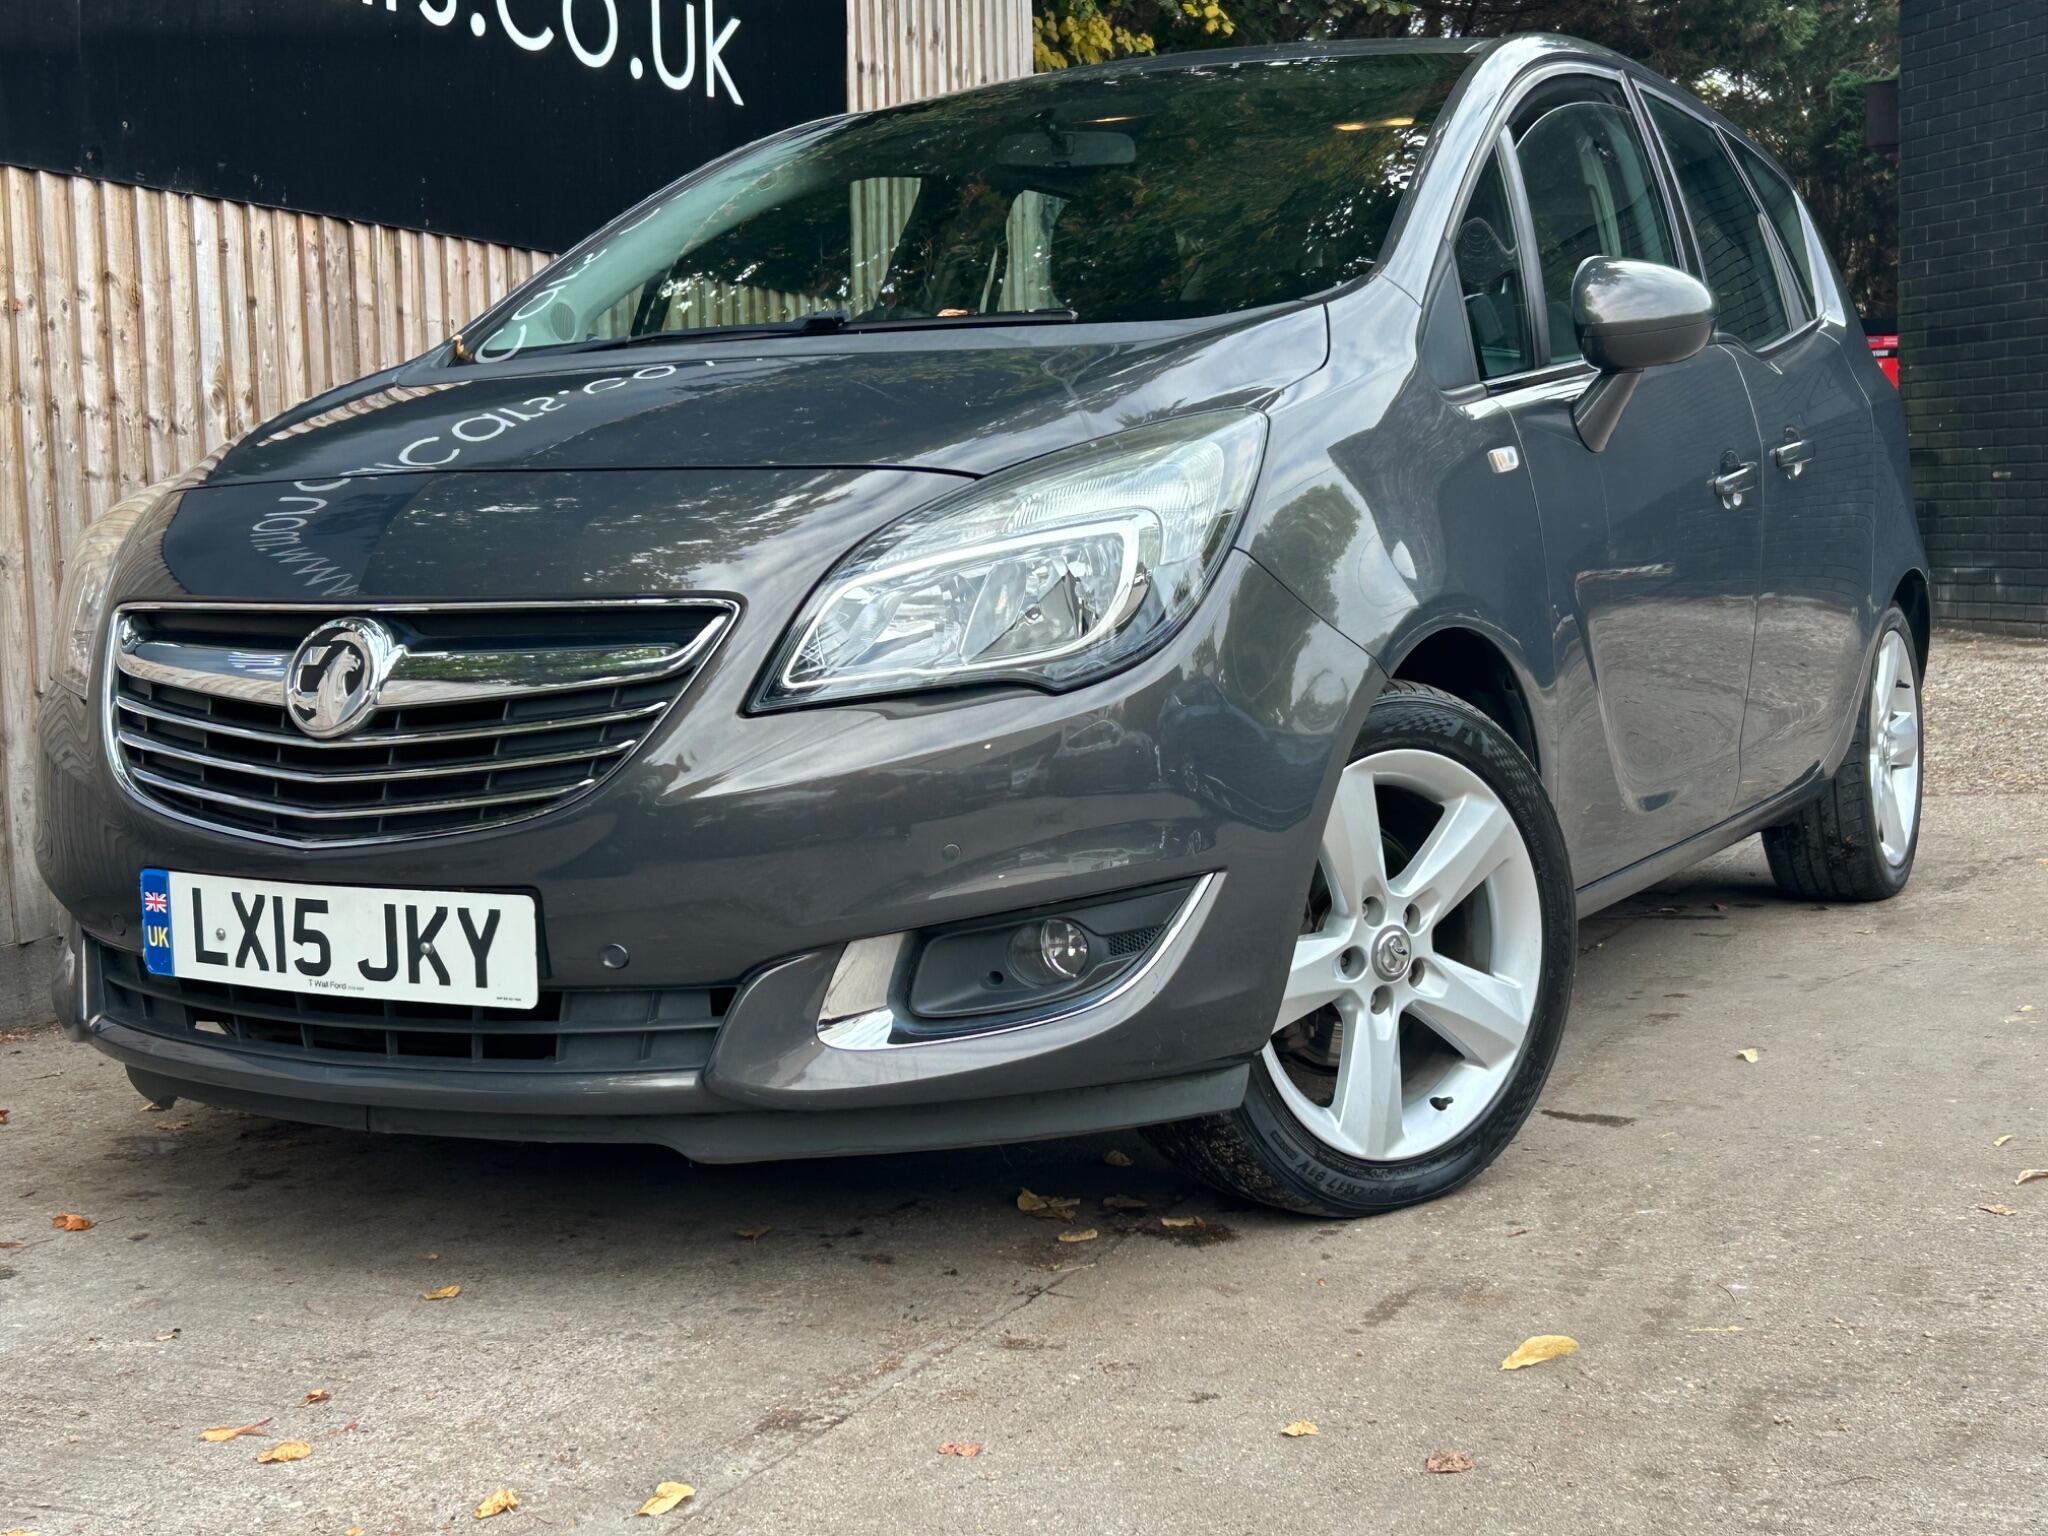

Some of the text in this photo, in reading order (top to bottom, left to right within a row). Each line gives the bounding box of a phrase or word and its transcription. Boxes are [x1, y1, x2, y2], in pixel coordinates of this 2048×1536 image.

[147, 925, 170, 949] UK
[191, 887, 501, 989] LX15 JKY
